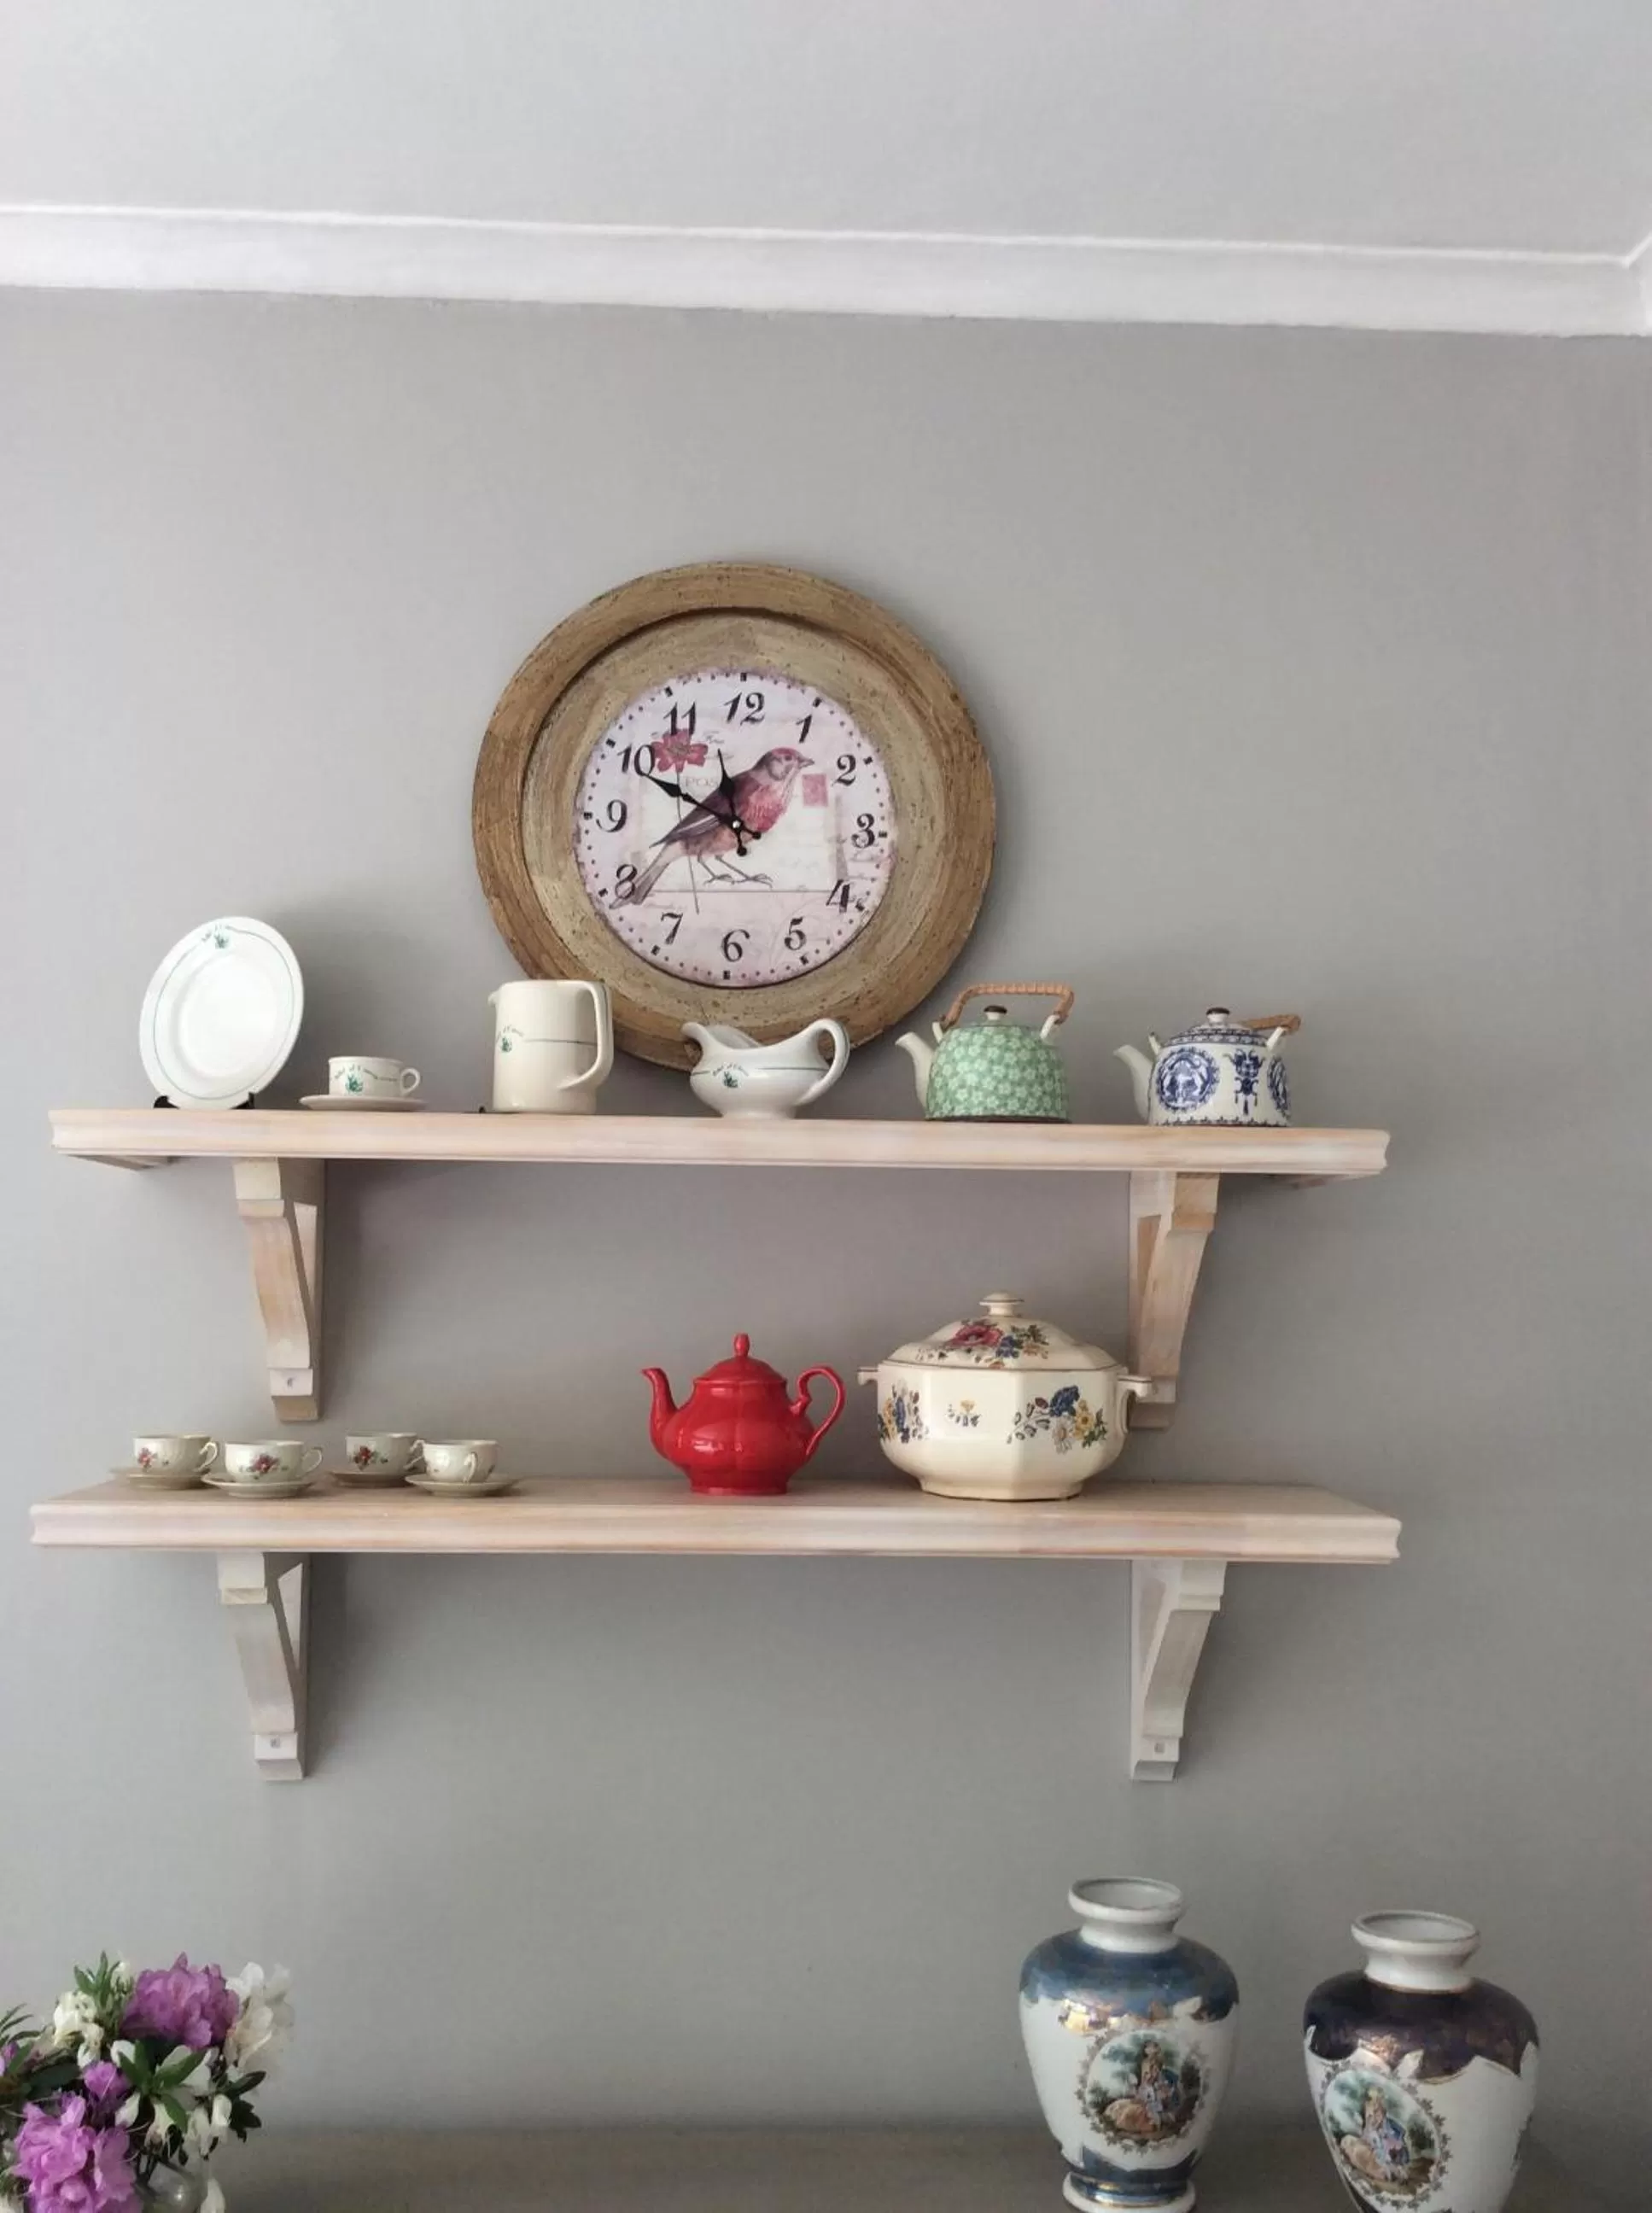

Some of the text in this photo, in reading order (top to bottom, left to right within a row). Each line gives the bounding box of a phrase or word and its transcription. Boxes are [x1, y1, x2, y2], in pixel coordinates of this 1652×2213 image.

[663, 702, 696, 735] 11
[724, 692, 765, 725] 12
[795, 715, 813, 743] 1
[617, 744, 655, 777] 10
[833, 755, 856, 786] 2
[597, 799, 628, 832] 9
[851, 814, 876, 849] 3
[616, 864, 638, 900] 8
[826, 879, 852, 914] 4
[661, 913, 683, 944] 7
[785, 918, 807, 951] 5
[722, 930, 750, 962] 6
